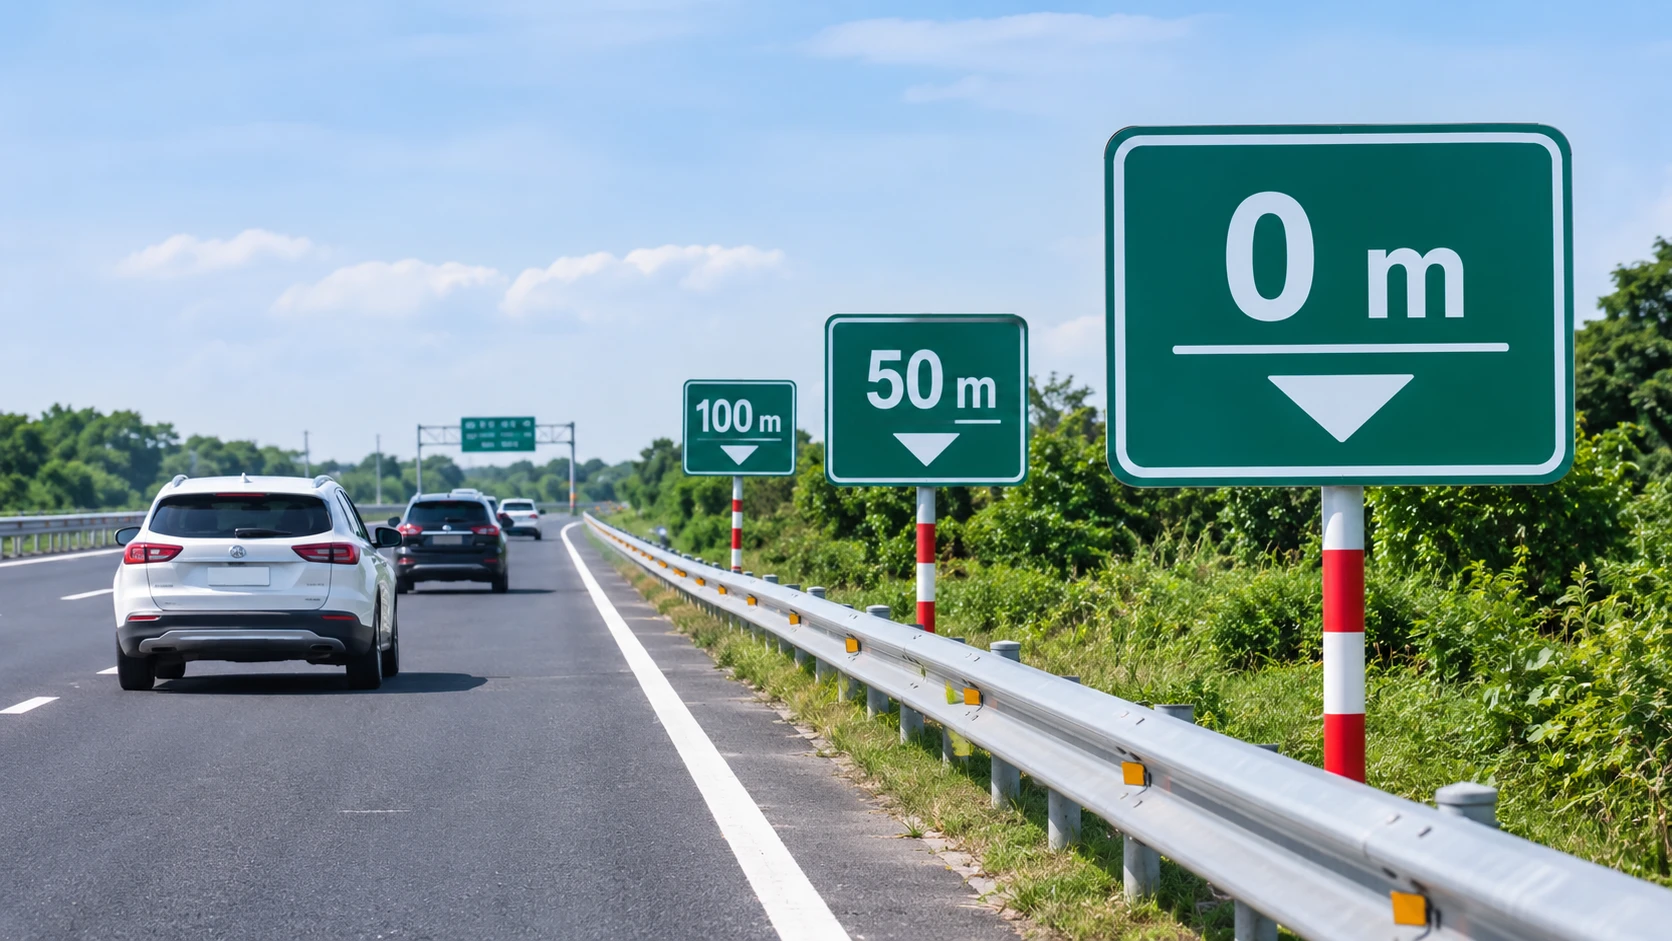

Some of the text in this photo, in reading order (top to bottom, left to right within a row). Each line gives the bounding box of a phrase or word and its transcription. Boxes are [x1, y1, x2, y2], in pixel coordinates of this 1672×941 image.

[1225, 191, 1464, 322] 0 m
[866, 349, 997, 410] 50 m
[695, 398, 782, 433] 100 m
